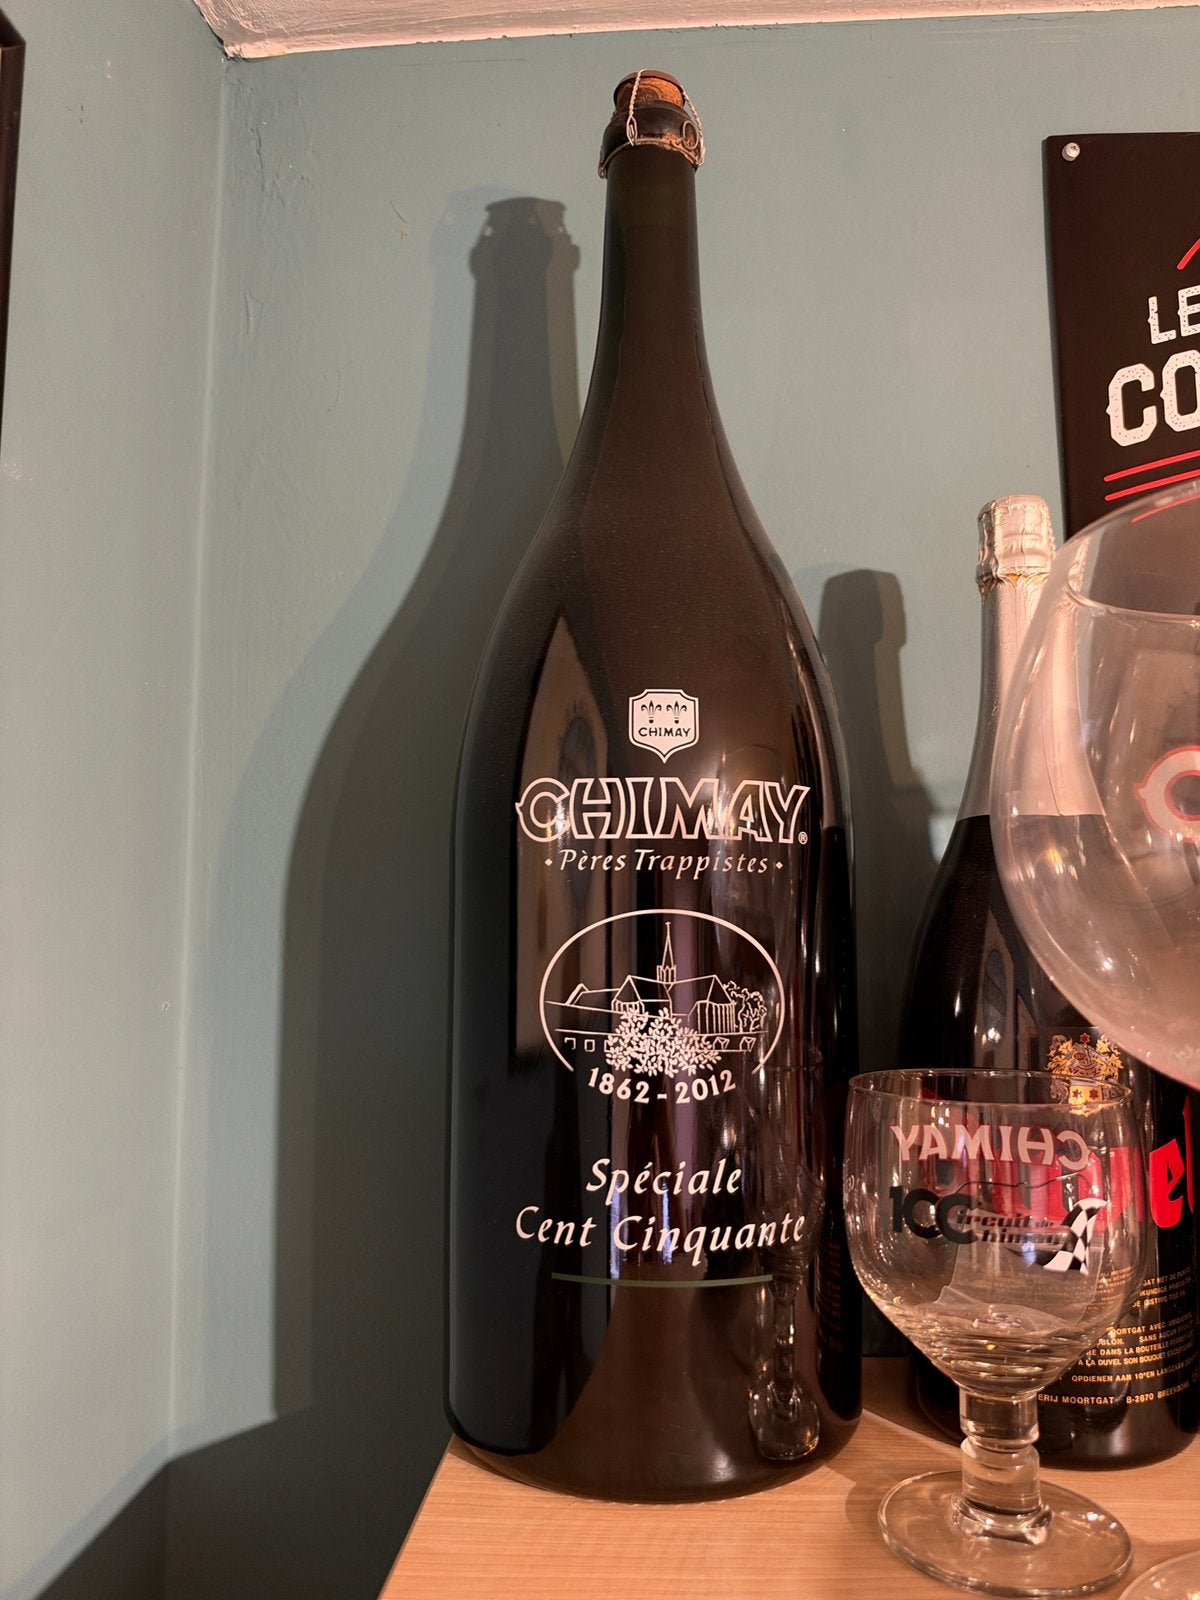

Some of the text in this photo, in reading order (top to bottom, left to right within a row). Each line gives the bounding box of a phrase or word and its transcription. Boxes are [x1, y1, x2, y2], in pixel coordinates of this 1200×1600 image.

[637, 726, 692, 738] CHIMAY
[559, 849, 769, 880] Pères Trappistes
[587, 1067, 650, 1104] 1862
[675, 1069, 737, 1104] 2012
[586, 1157, 742, 1206] Spéciale
[515, 1205, 806, 1267] Cent Cinquante
[1099, 1348, 1122, 1356] DANS
[1124, 1347, 1134, 1355] LA
[1098, 1358, 1122, 1366] DUVEL
[1123, 1356, 1139, 1365] SON
[1071, 1374, 1113, 1382] OPDIENEN
[1062, 1396, 1115, 1405] MOORTGAT
[1126, 1393, 1154, 1404] B-2870
